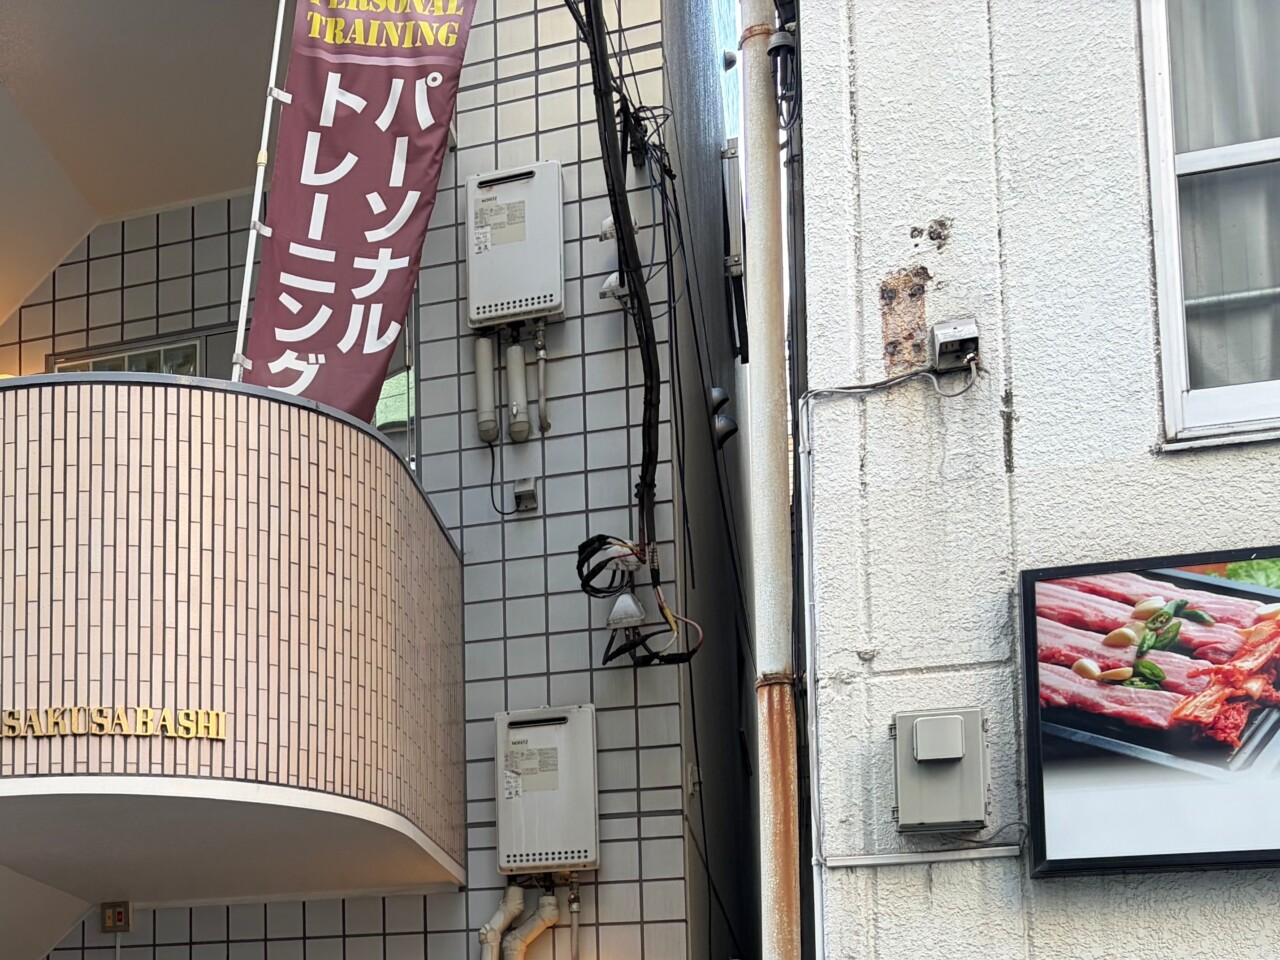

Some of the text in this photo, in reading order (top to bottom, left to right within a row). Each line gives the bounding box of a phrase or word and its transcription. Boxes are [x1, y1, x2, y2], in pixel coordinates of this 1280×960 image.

[307, 11, 460, 49] TRAINING
[267, 71, 368, 396] トレーニング
[337, 71, 443, 355] パーソナル
